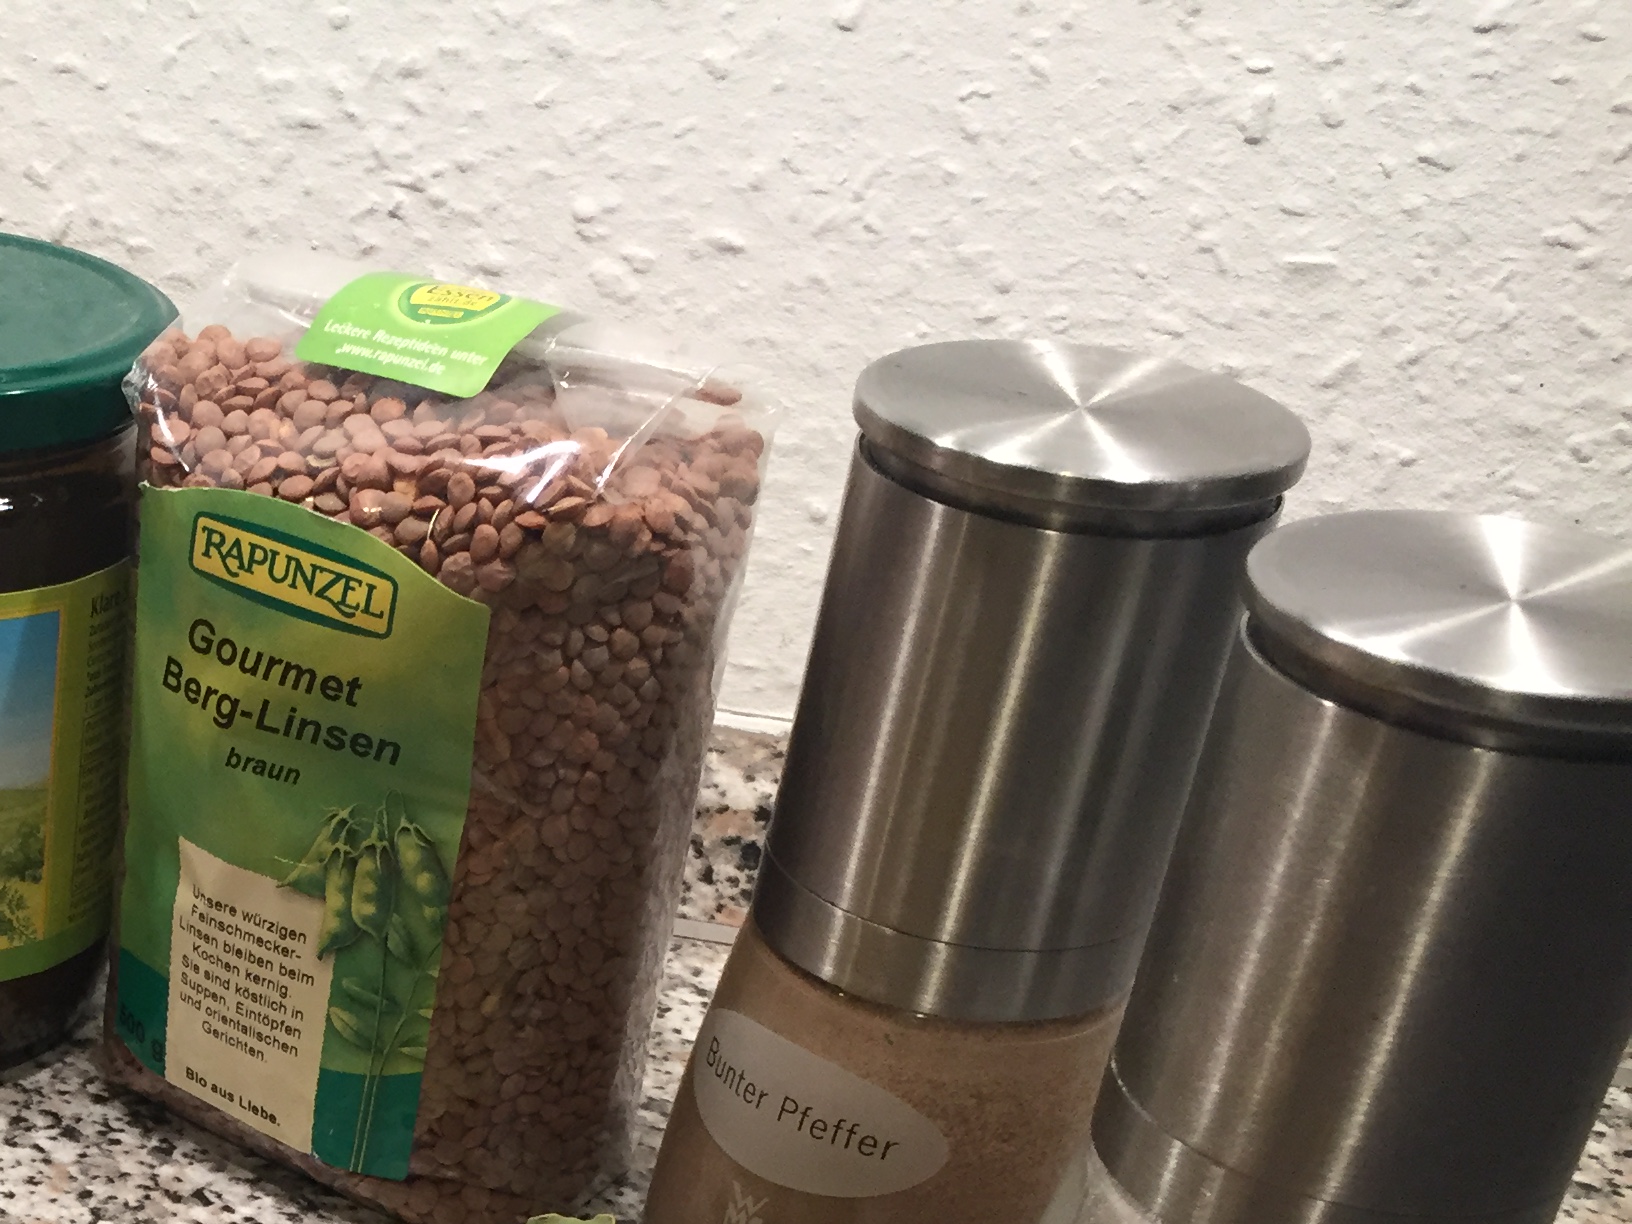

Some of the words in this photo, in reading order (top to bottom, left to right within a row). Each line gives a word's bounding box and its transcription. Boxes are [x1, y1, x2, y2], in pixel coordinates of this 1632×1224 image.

[324, 319, 372, 339] Leckere
[373, 329, 449, 357] Rezeptideen
[450, 350, 488, 366] unter
[202, 525, 385, 620] RAPUNZEL
[188, 618, 363, 707] Gourmet
[162, 655, 402, 766] Berg-Linsen
[225, 747, 301, 786] braun
[191, 904, 302, 960] Feinschmecker-
[192, 884, 238, 918] Unsere
[241, 910, 307, 945] würzigen
[179, 916, 219, 950] Linsen
[223, 938, 274, 973] bleiben
[279, 962, 315, 987] beim
[192, 942, 241, 977] Kochen
[244, 964, 292, 999] kernig.
[180, 972, 231, 1012] Suppen,
[235, 1001, 302, 1040] Eintöpfen
[181, 954, 201, 976] Sie
[203, 967, 231, 992] sind
[234, 979, 288, 1016] köstlich
[291, 1004, 304, 1022] in
[179, 990, 202, 1012] und
[205, 1004, 299, 1058] orientalischen
[201, 1020, 268, 1063] Gerichten.
[185, 1065, 208, 1089] Bio
[210, 1083, 235, 1104] aus
[238, 1095, 281, 1128] Liebe.
[705, 1036, 769, 1110] Bunter
[776, 1095, 900, 1161] Pfeffer
